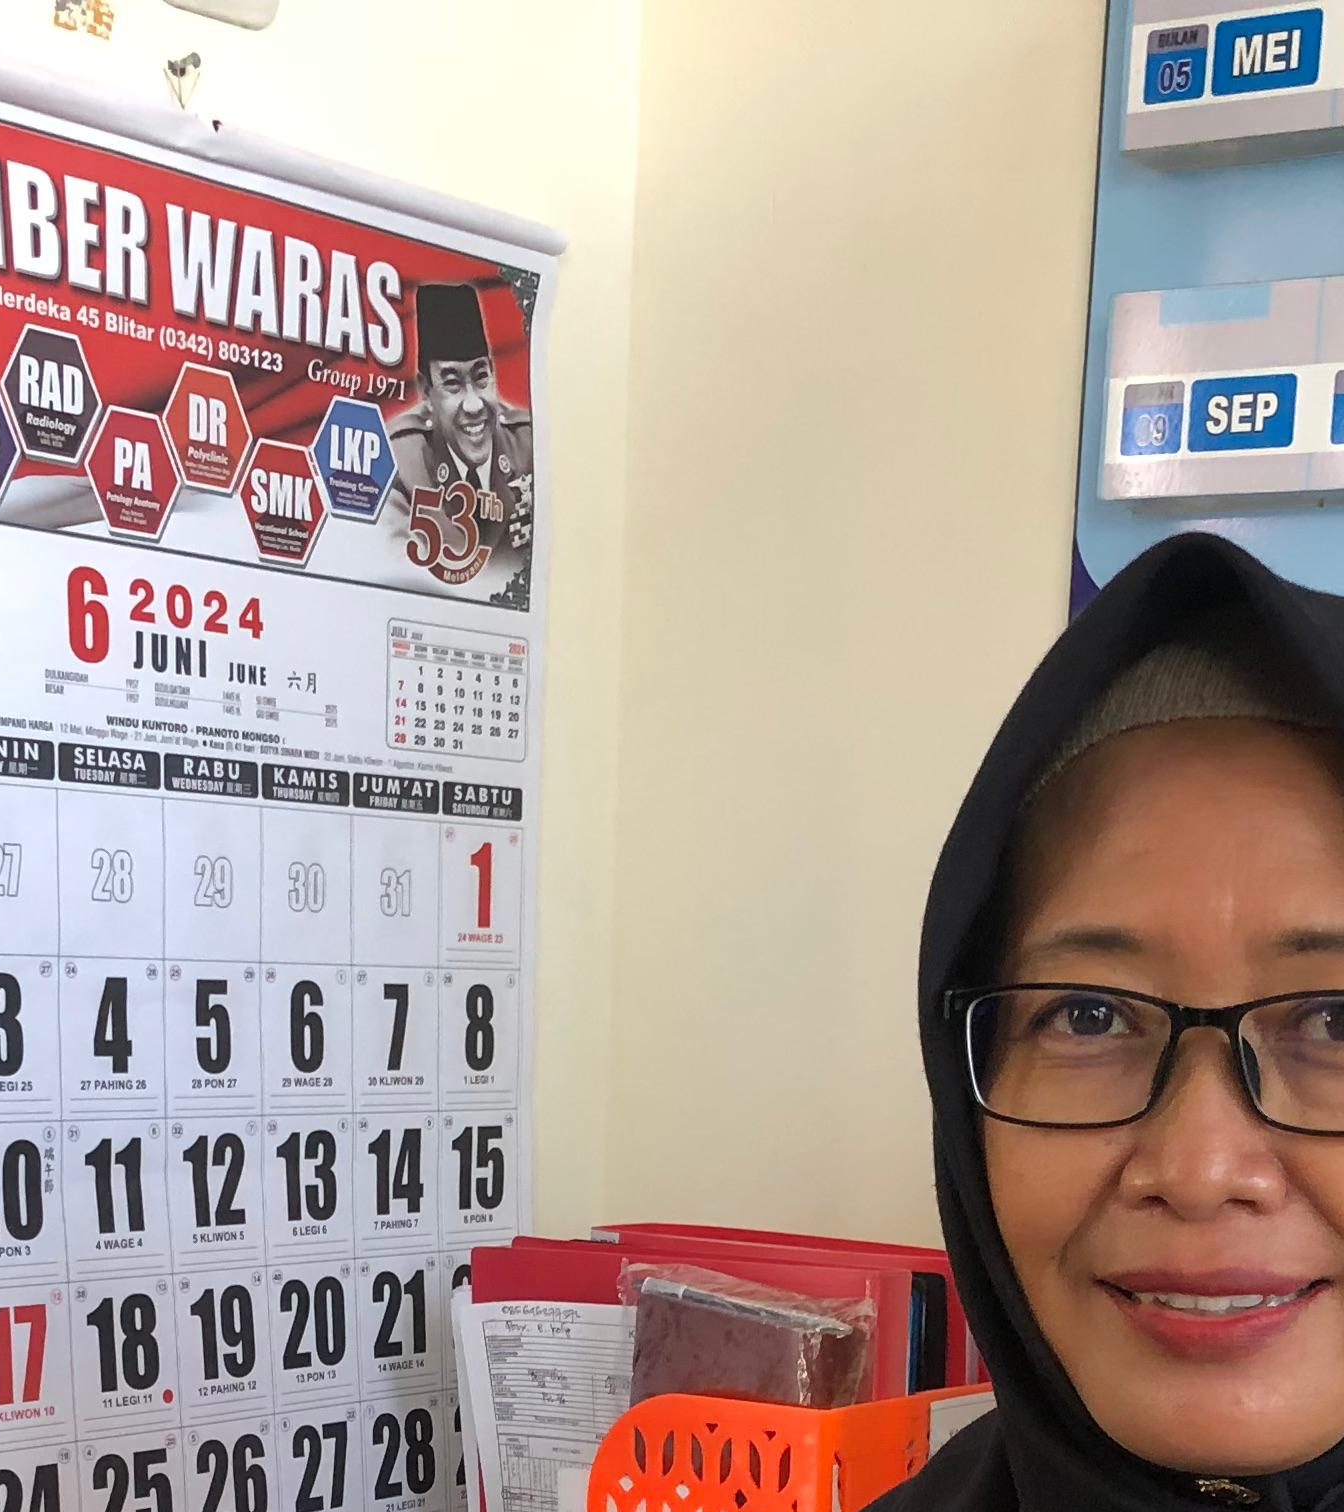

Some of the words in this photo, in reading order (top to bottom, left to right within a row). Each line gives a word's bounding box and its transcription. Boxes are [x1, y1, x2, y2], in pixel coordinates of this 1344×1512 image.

[1157, 29, 1200, 48] BULAN
[1231, 29, 1303, 77] MEI
[1158, 59, 1193, 95] 05
[166, 203, 406, 368] WARAS
[76, 304, 101, 328] 45
[105, 309, 155, 340] Blitar
[159, 326, 214, 361] (0342)
[218, 343, 284, 373] 803123
[19, 353, 85, 416] RAD
[307, 359, 361, 396] Group
[366, 371, 407, 401] 1971
[26, 413, 77, 436] Radiology
[188, 393, 228, 447] DR
[1204, 392, 1279, 435] SEP
[114, 437, 153, 491] PA
[188, 446, 229, 465] Polyclinic
[328, 424, 381, 476] LKP
[251, 468, 314, 521] SMK
[406, 480, 480, 568] 53
[476, 488, 504, 522] Th
[67, 565, 111, 664] 6
[129, 578, 265, 640] 2024
[391, 626, 408, 640] JULI
[133, 630, 208, 678] JUNI
[228, 661, 267, 687] JUNE
[287, 671, 318, 695] 六月
[106, 714, 140, 730] WINDU
[142, 718, 188, 735] KUNTORO
[196, 725, 240, 741] PRANOTO
[242, 730, 280, 745] MONGSO
[73, 743, 147, 771] SELASA
[74, 767, 115, 784] TUESDAY
[183, 757, 241, 780] RABU
[273, 767, 338, 789] KAMIS
[172, 776, 225, 794] WEDNESDAY
[272, 785, 314, 801] THURSDAY
[369, 795, 399, 809] FRIDAY
[454, 785, 513, 806] SABTU
[90, 848, 134, 903] 28
[193, 855, 234, 908] 29
[288, 861, 327, 913] 30
[380, 867, 412, 917] 31
[469, 842, 493, 928] 1
[93, 976, 133, 1074] 4
[195, 979, 232, 1074] 5
[290, 979, 325, 1074] 6
[383, 983, 410, 1071] 7
[464, 983, 495, 1072] 8
[21, 1081, 33, 1092] 25
[84, 1136, 145, 1234] 11
[182, 1132, 246, 1228] 12
[276, 1129, 337, 1222] 13
[368, 1127, 424, 1216] 14
[451, 1125, 505, 1210] 15
[189, 1284, 256, 1380] 19
[279, 1275, 347, 1371] 20
[372, 1269, 427, 1359] 21
[86, 1292, 160, 1393] 18
[372, 1408, 436, 1500] 28
